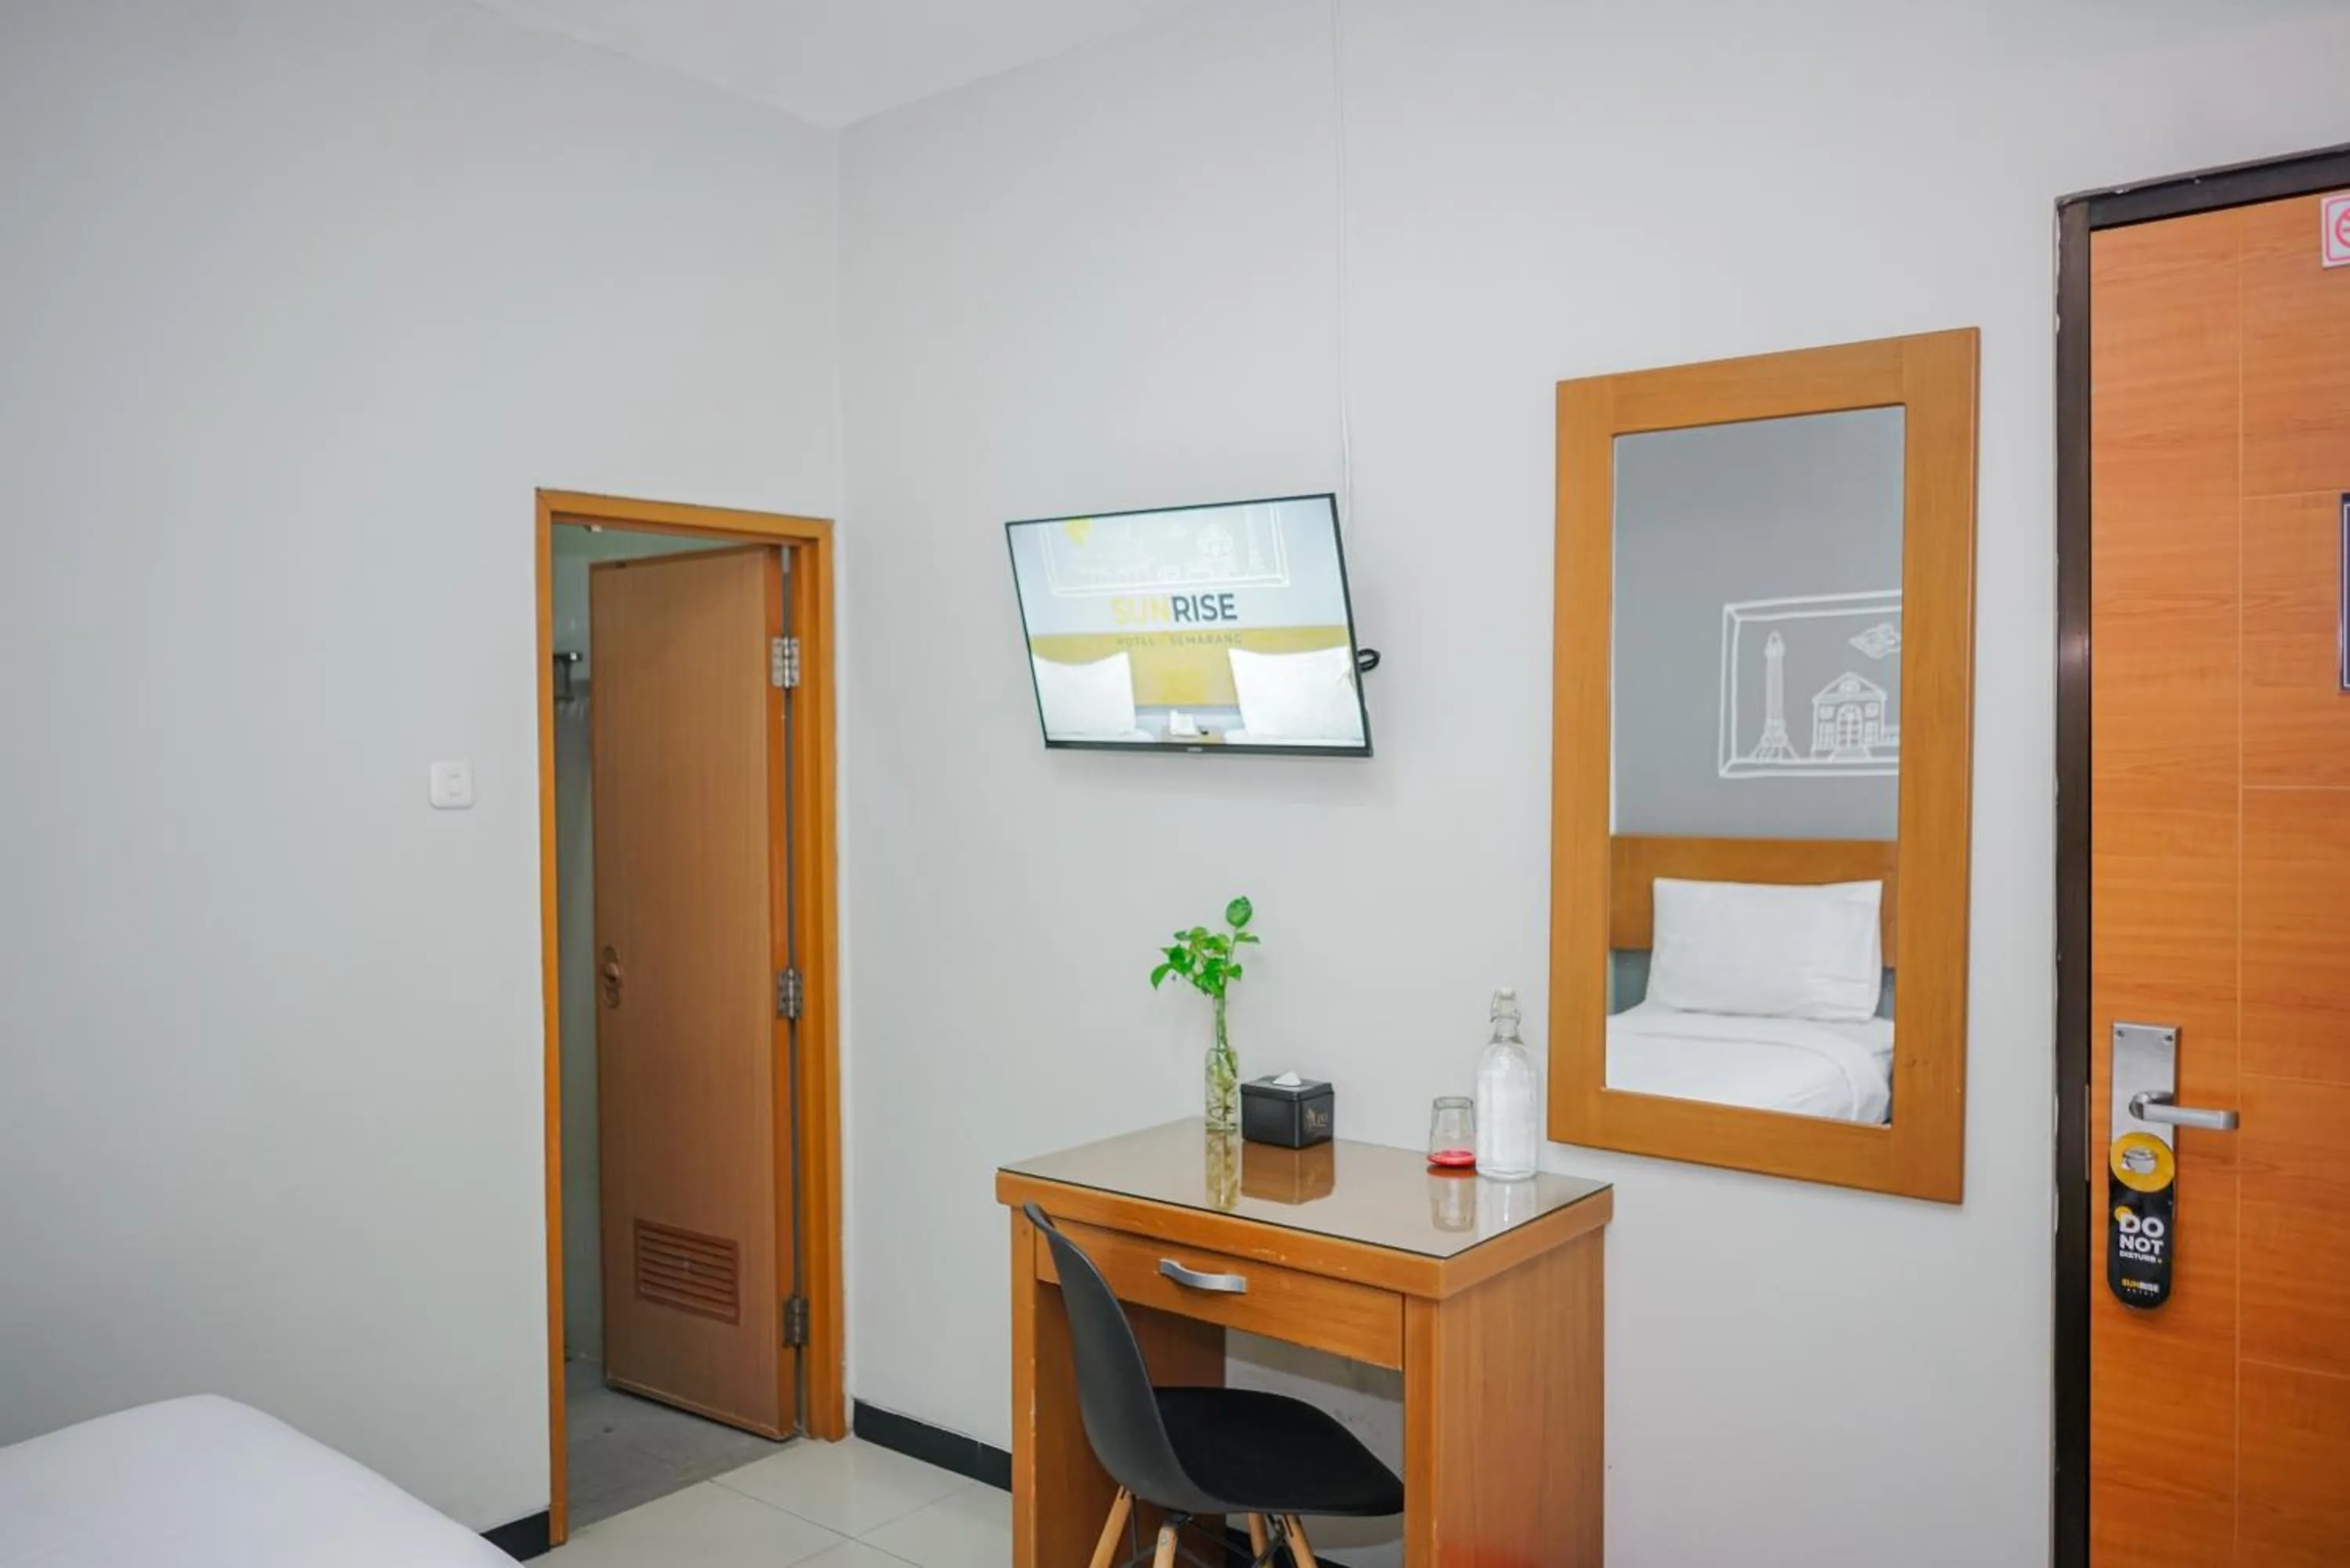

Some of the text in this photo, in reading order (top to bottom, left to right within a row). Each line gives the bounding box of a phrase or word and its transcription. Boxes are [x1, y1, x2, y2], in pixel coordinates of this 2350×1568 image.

[1111, 593, 1238, 626] SUNRISE
[1170, 634, 1242, 647] SEMARANG
[2120, 1214, 2164, 1238] DO
[2120, 1234, 2164, 1255] NOT
